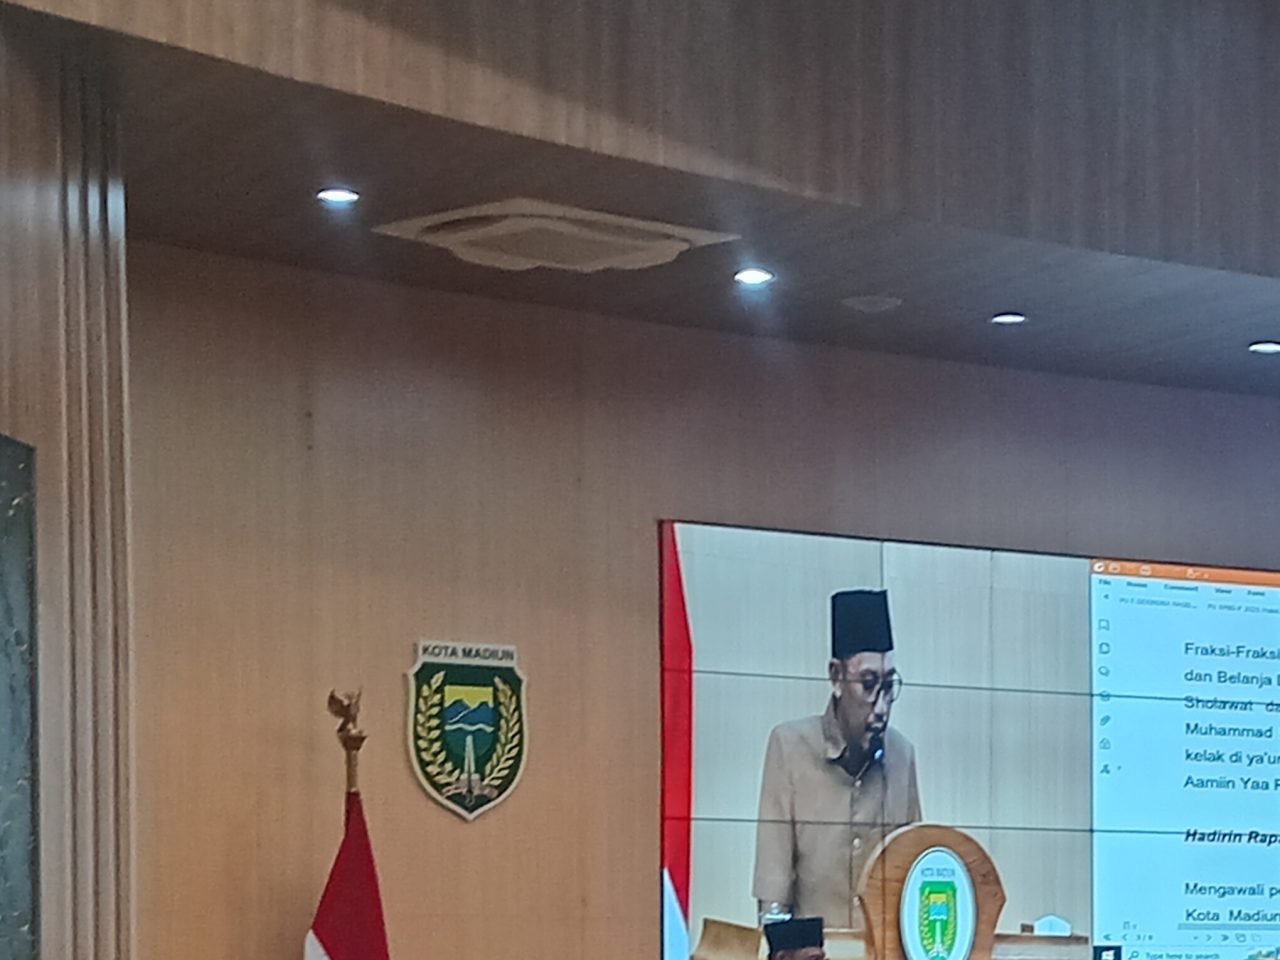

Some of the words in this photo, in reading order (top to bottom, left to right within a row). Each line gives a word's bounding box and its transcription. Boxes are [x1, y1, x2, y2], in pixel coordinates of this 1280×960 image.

[422, 643, 458, 658] KOTA
[461, 646, 515, 661] MADIUN
[1184, 643, 1280, 660] Fraksi-Fraksi
[1184, 669, 1212, 683] dan
[1218, 671, 1272, 688] Belanja
[1184, 696, 1253, 712] Sholawat
[1185, 723, 1272, 739] Muhammad
[1185, 750, 1225, 764] kelak
[1231, 751, 1243, 764] di
[1184, 776, 1235, 790] Aamiin
[1240, 777, 1269, 791] Yaa
[1185, 829, 1242, 844] Hadirin
[1184, 882, 1264, 898] Mengawali
[1185, 909, 1220, 922] Kota
